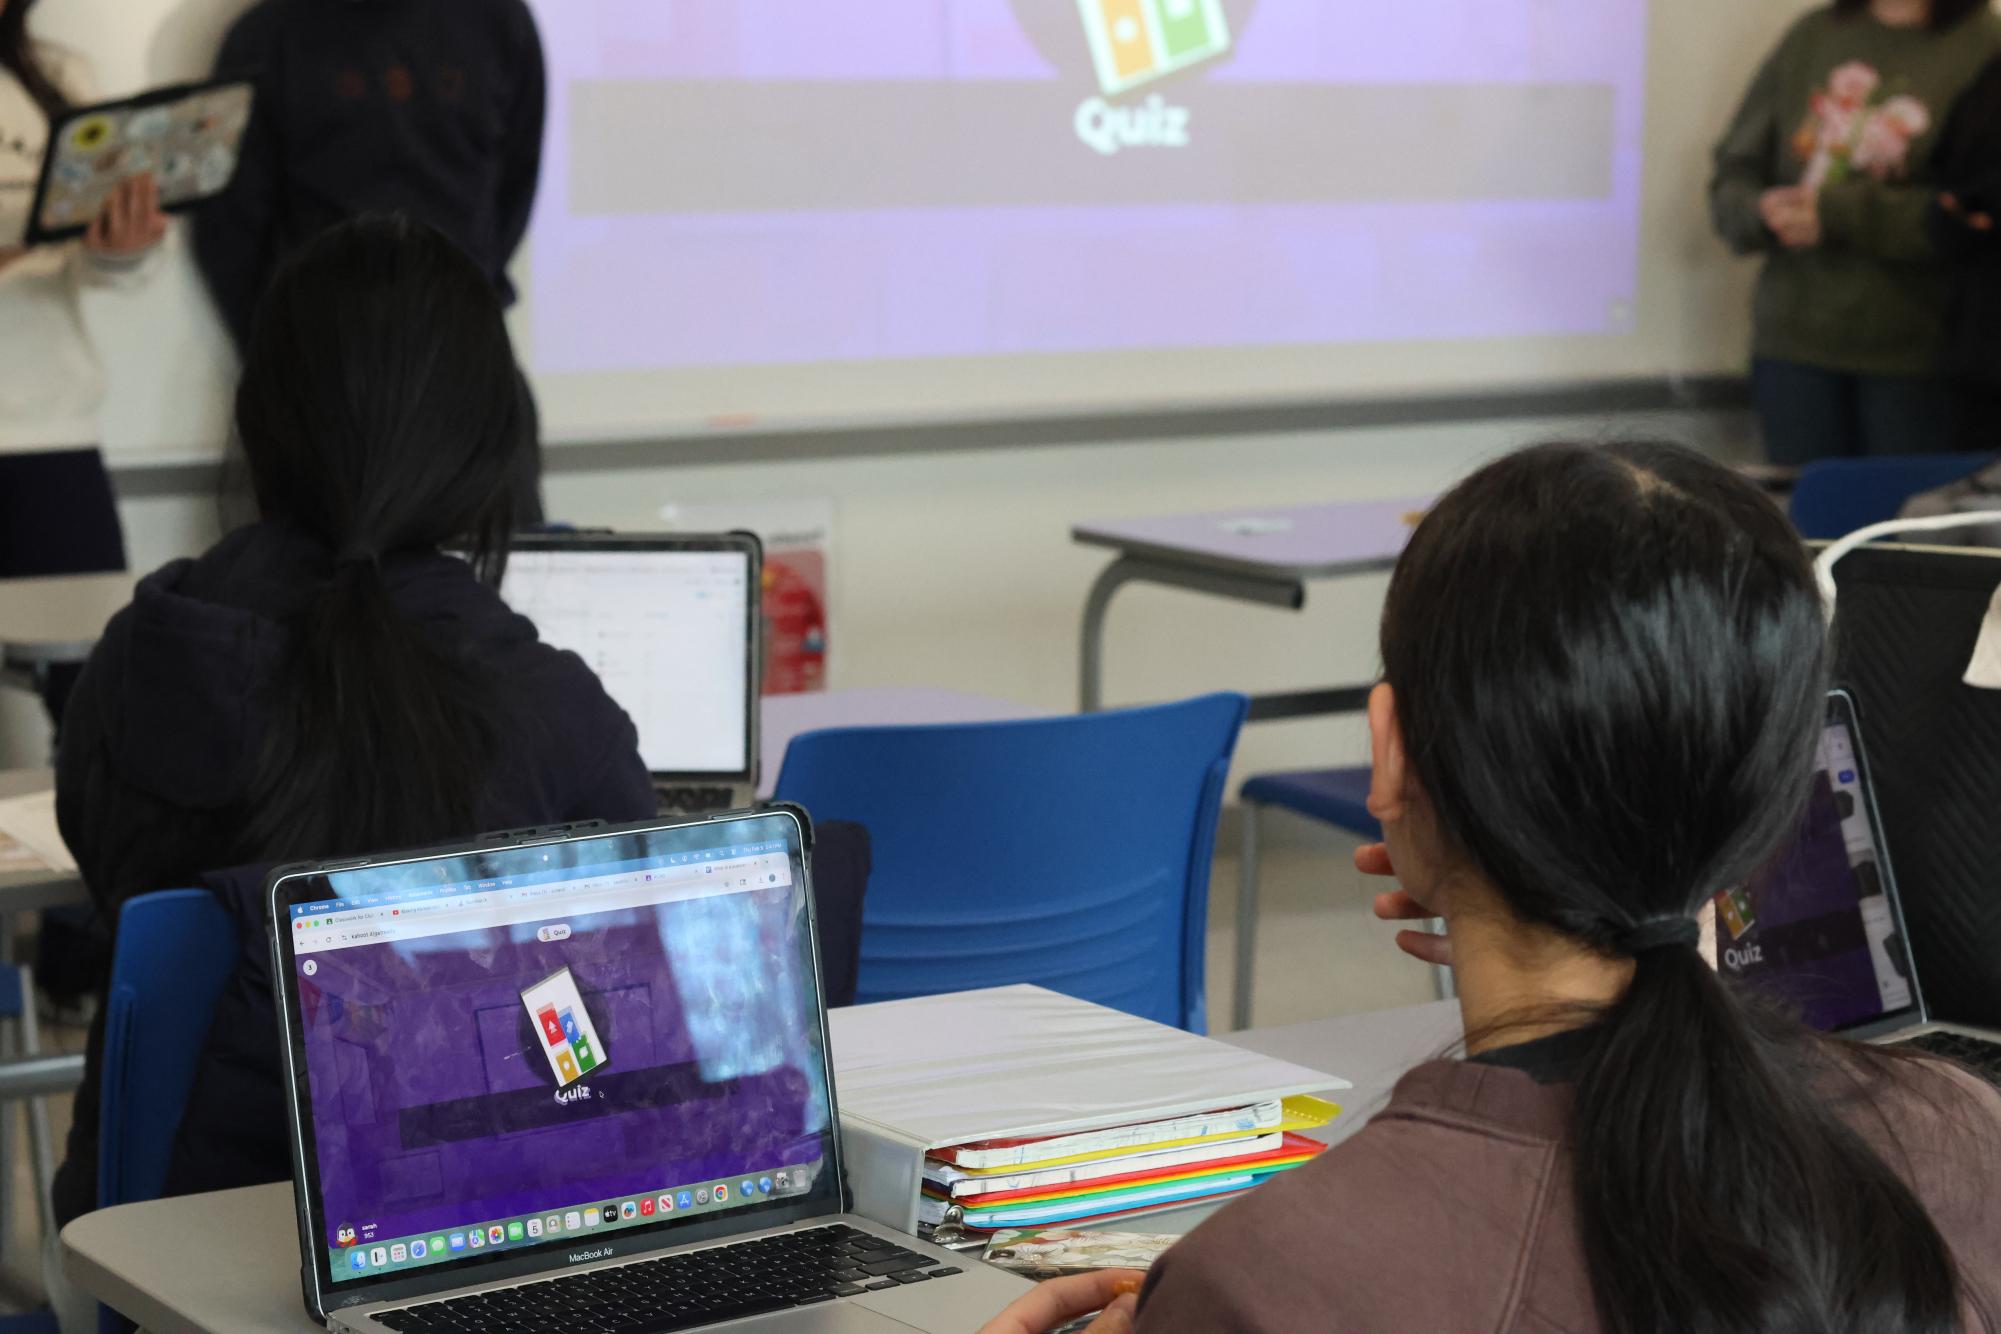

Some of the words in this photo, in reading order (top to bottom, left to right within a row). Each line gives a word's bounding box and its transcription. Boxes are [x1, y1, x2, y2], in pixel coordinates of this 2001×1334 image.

[1073, 95, 1190, 155] Quiz
[1724, 943, 1763, 970] Quiz
[554, 1084, 592, 1106] Quiz
[532, 1225, 538, 1234] 5
[569, 1249, 602, 1263] MacBook
[603, 1247, 614, 1256] Air
